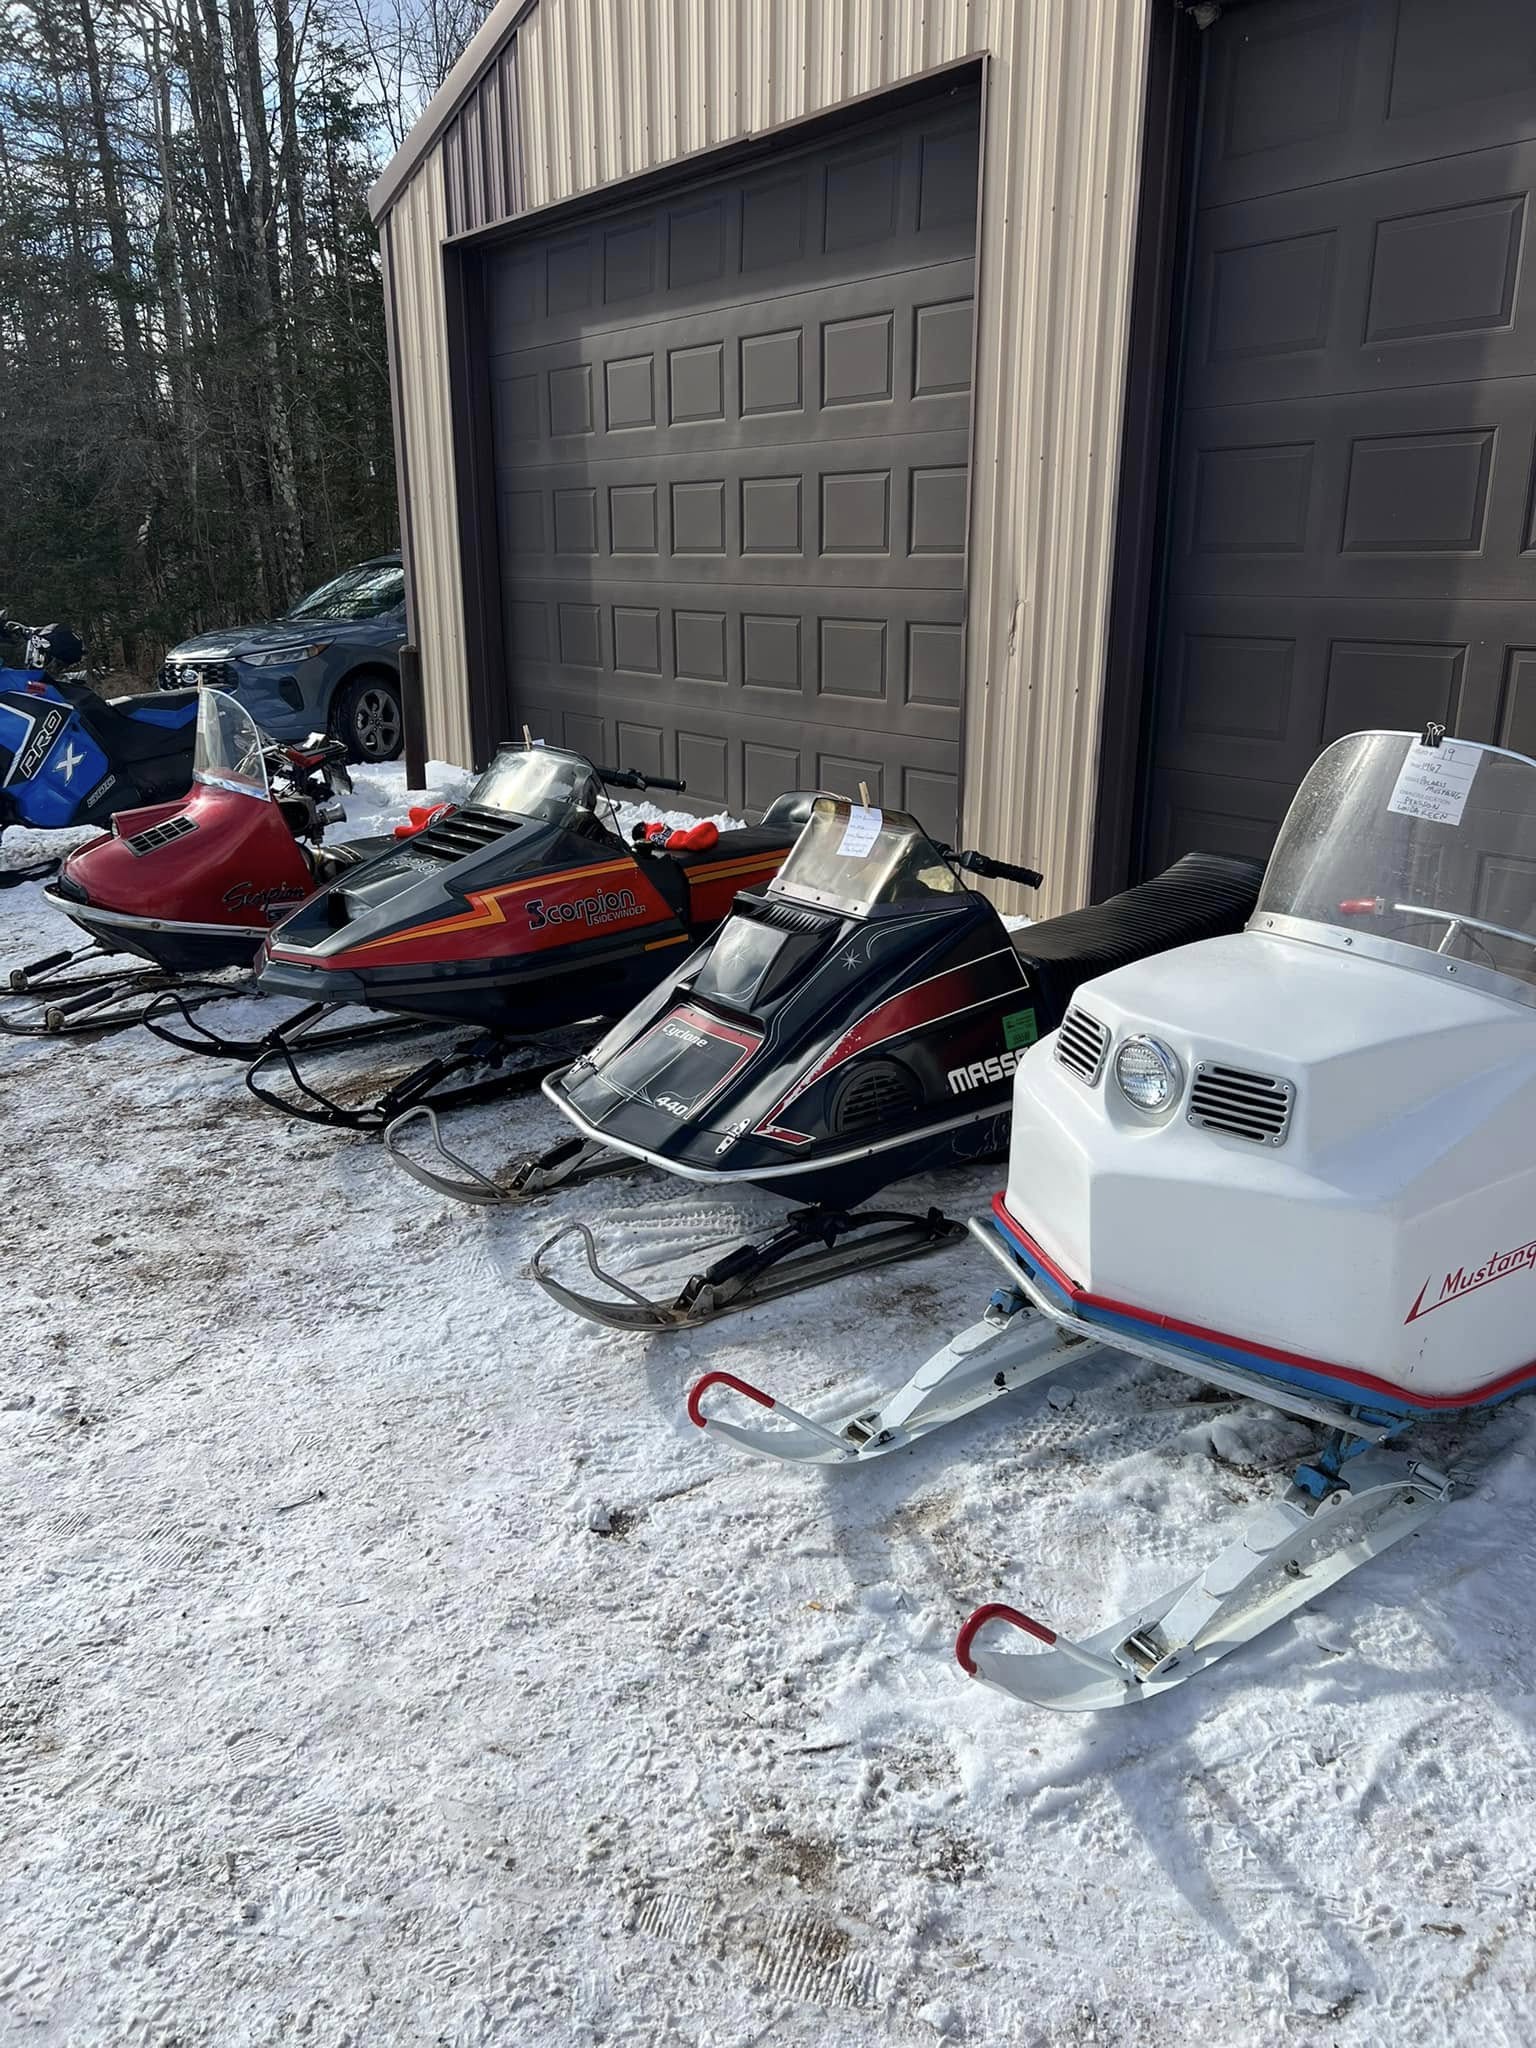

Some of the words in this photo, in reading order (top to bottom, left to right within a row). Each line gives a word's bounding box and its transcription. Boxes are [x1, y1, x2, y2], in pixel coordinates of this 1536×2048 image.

[20, 709, 62, 778] PRO
[51, 741, 87, 787] X
[525, 888, 636, 930] Scorpion
[592, 904, 647, 925] SIDEWINDER
[662, 1023, 708, 1048] Cyclone
[655, 1096, 689, 1116] 440
[1439, 1243, 1536, 1300] Mustang
